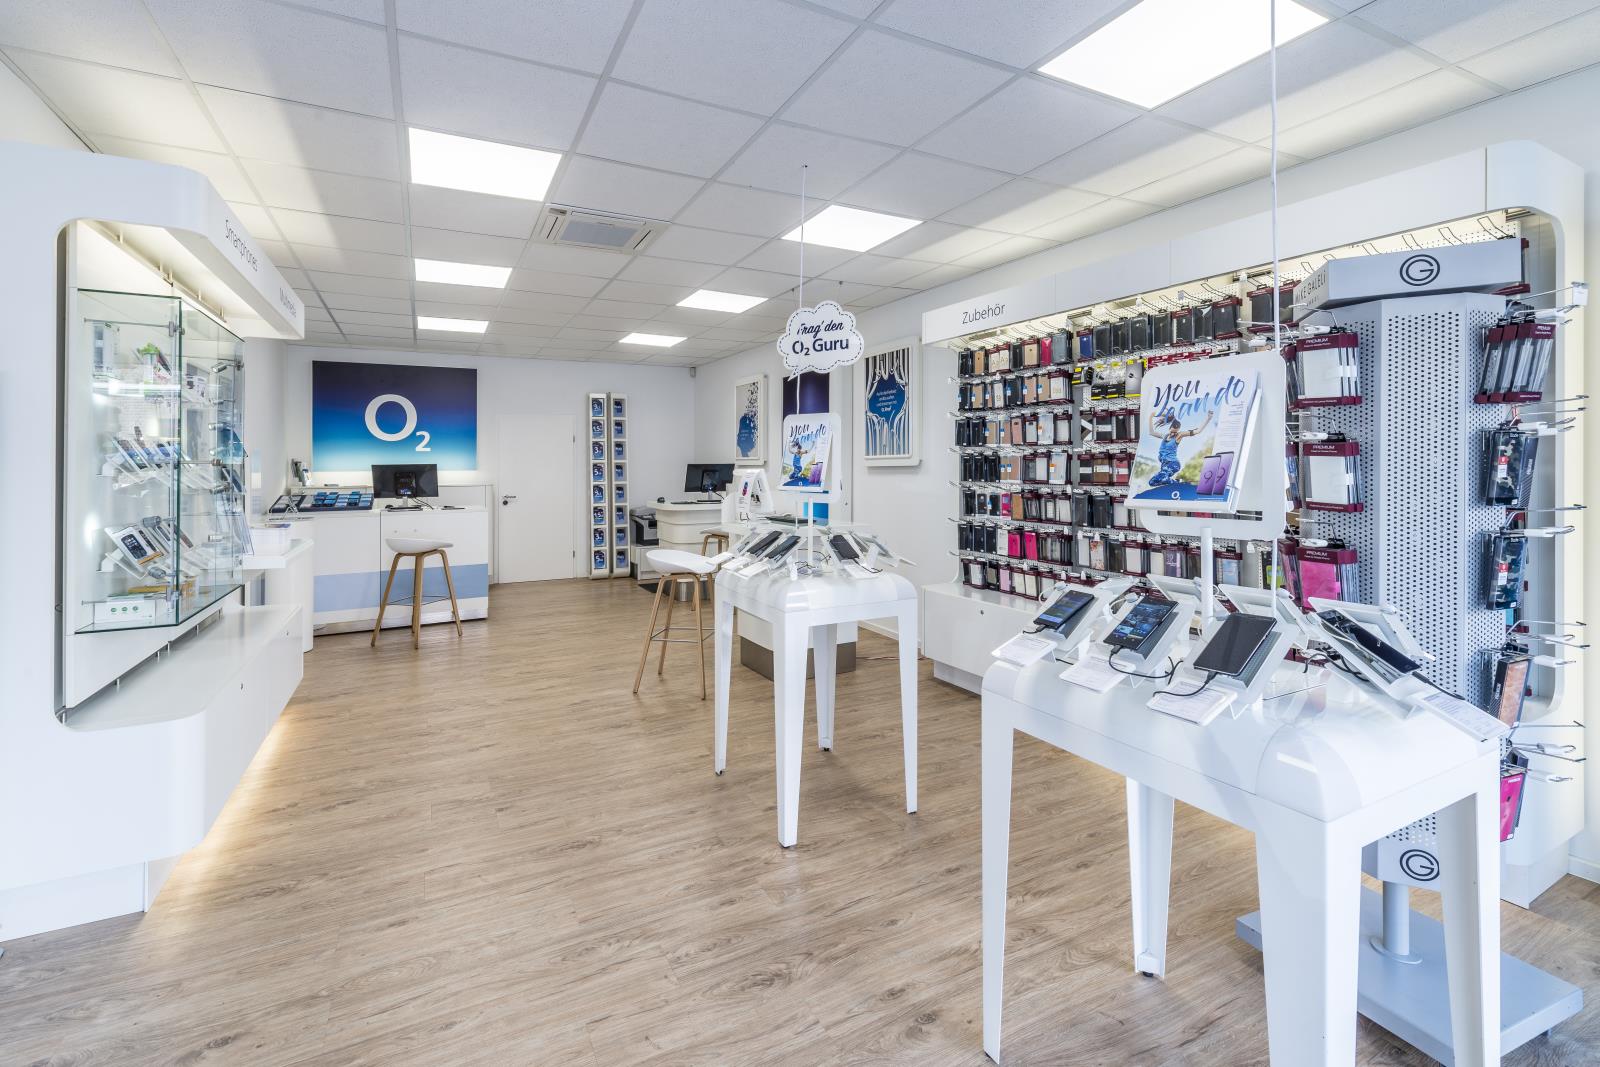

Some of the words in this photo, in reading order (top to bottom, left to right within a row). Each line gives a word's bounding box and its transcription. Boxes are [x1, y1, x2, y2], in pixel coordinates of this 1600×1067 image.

[961, 303, 1006, 325] Zubehör
[824, 320, 845, 332] den
[792, 340, 811, 356] O2
[812, 338, 849, 352] Guru
[1214, 376, 1245, 404] do
[364, 393, 432, 452] O2
